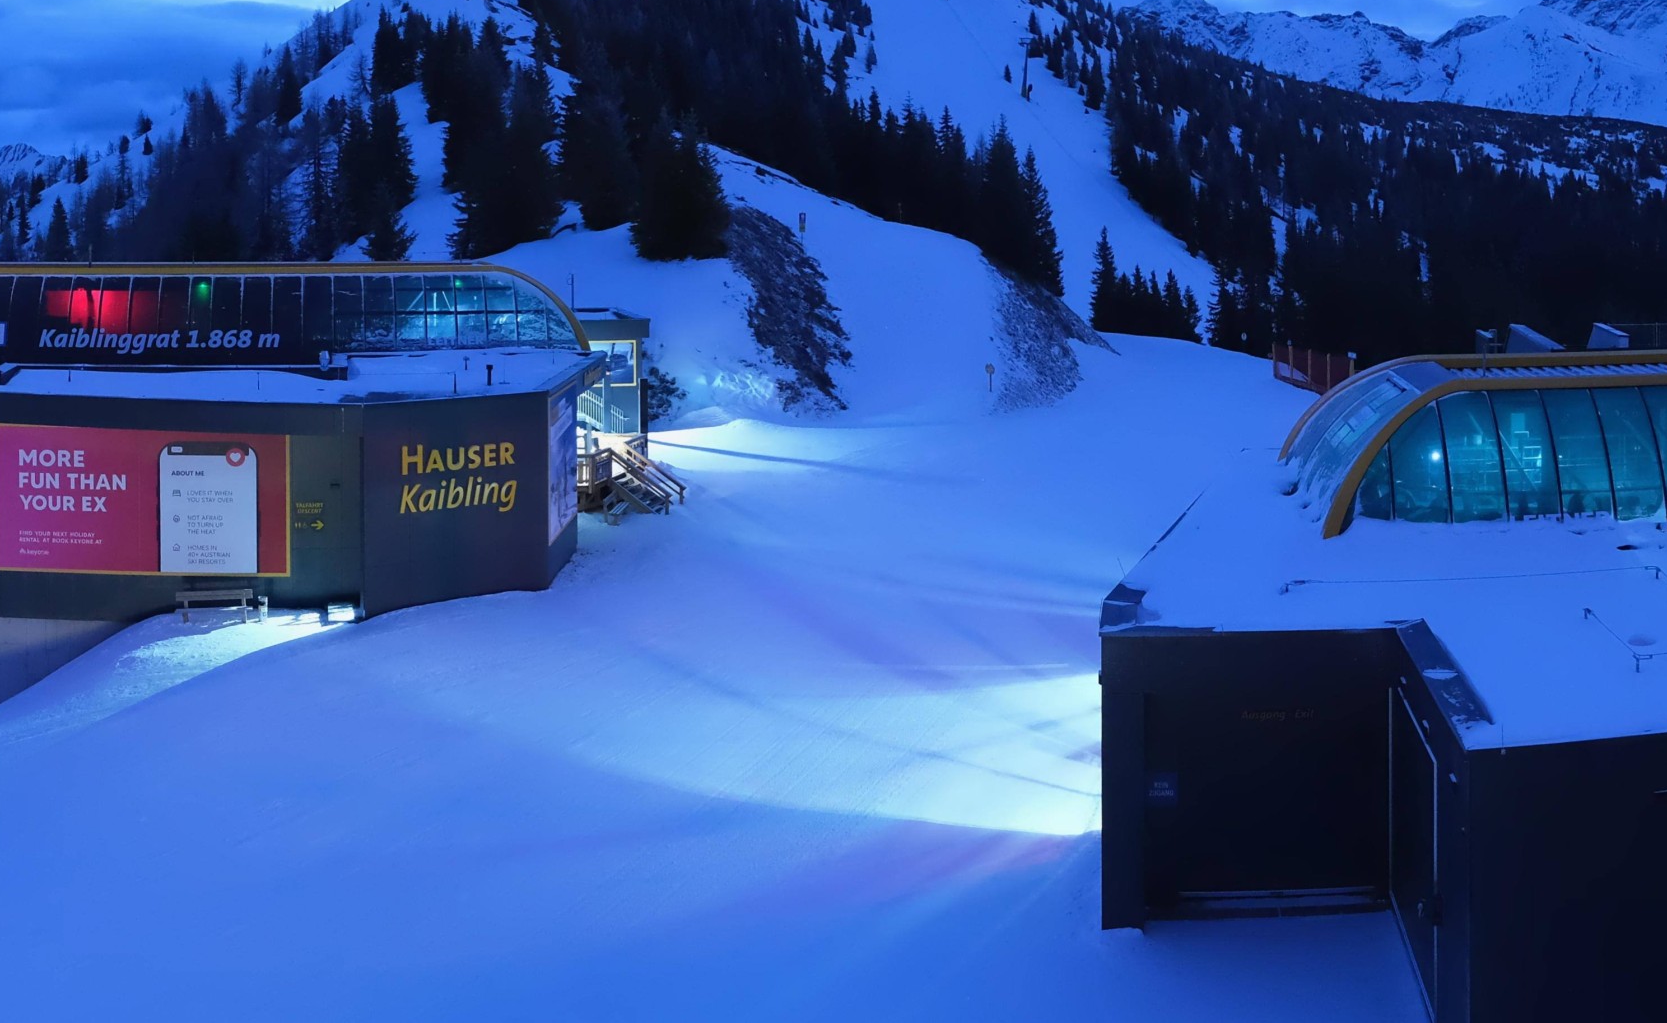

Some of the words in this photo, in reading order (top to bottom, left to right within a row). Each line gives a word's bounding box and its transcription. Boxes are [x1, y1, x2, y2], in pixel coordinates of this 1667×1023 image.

[38, 327, 180, 354] Kaiblinggrat
[185, 329, 253, 348] 1.868
[257, 332, 281, 348] m
[18, 448, 85, 468] MORE
[401, 441, 515, 476] HAUSER
[18, 472, 60, 489] FUN
[67, 473, 127, 491] THAN
[19, 494, 76, 512] YOUR
[81, 496, 107, 513] EX
[399, 476, 518, 514] Kaibling
